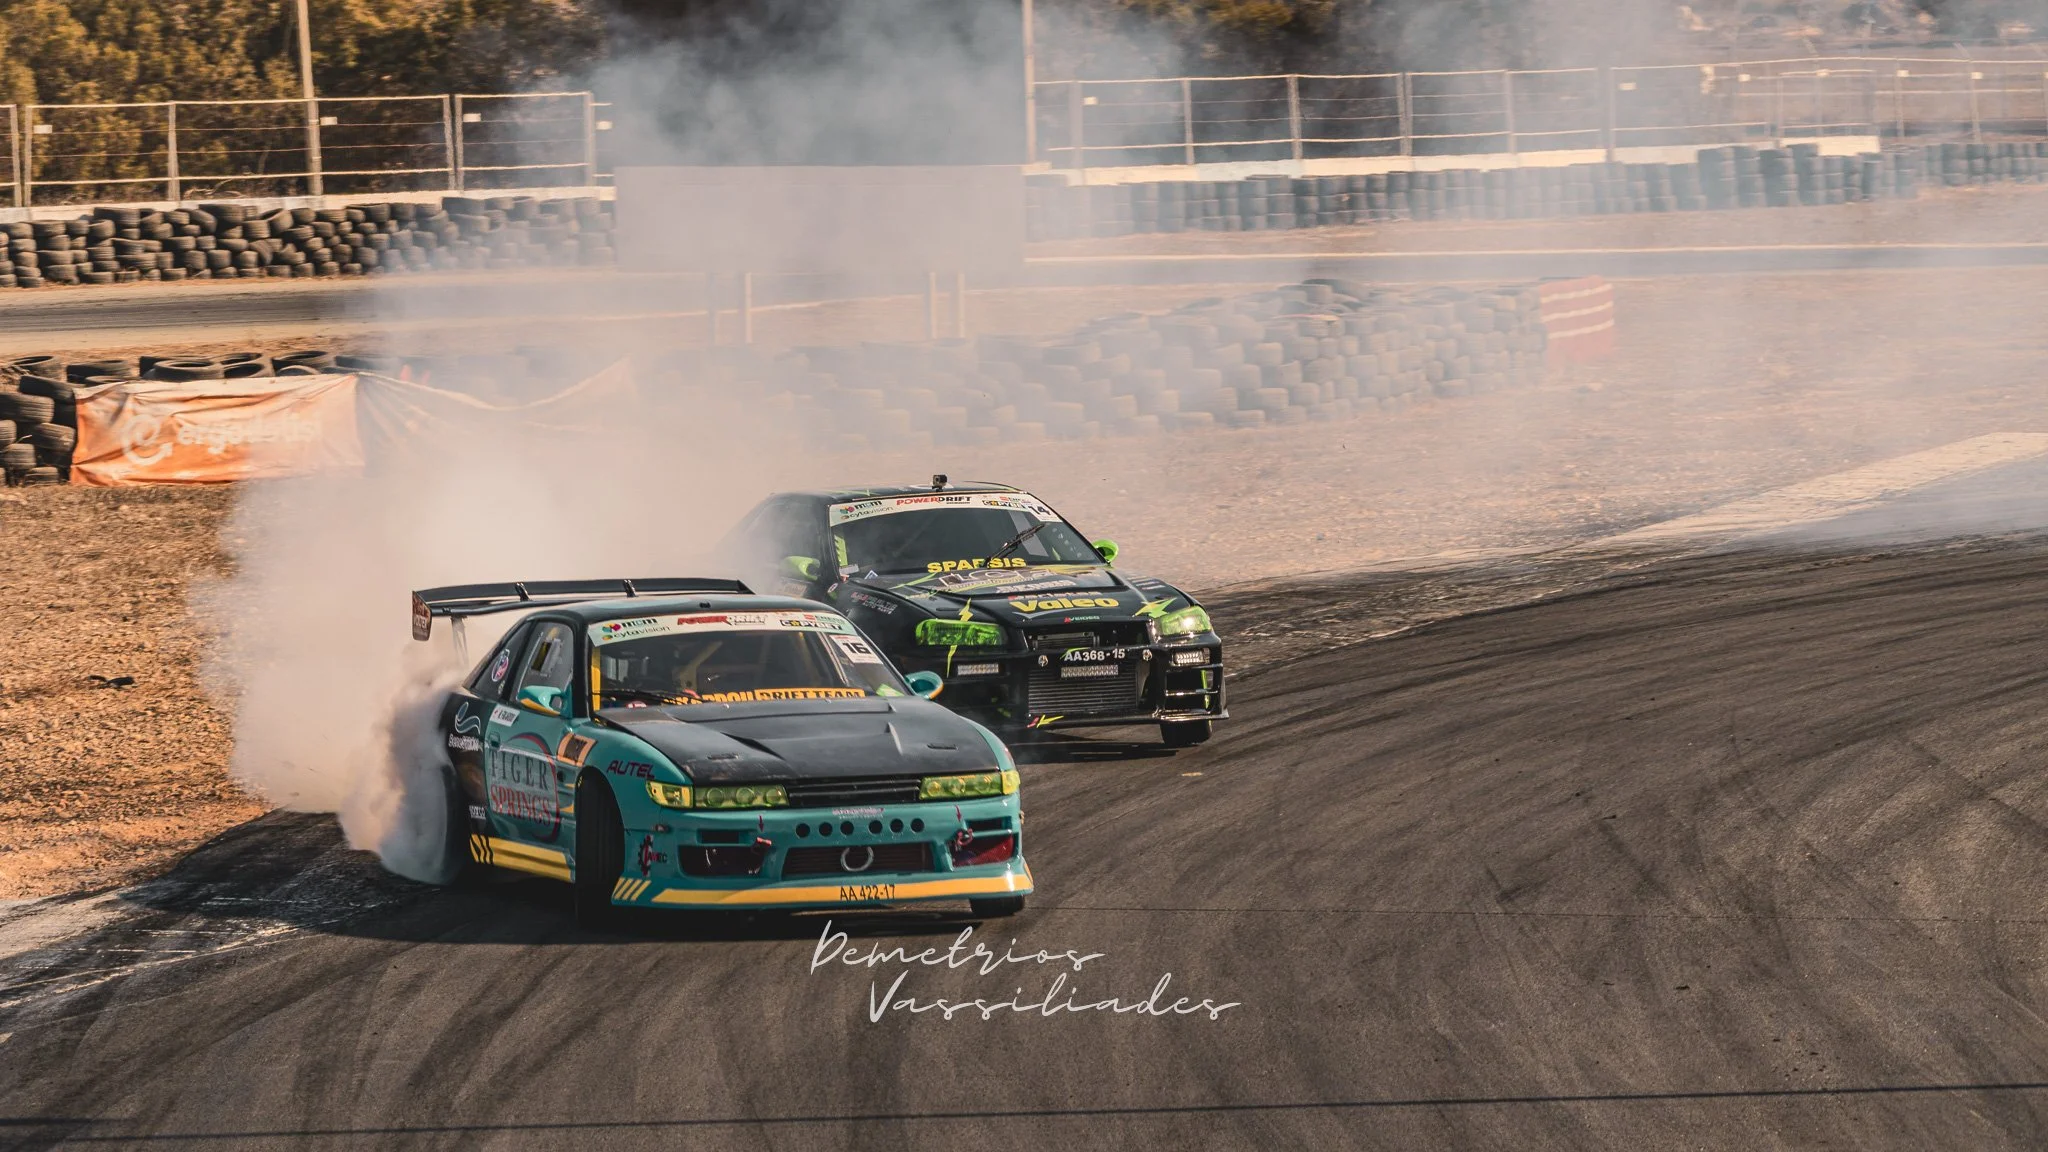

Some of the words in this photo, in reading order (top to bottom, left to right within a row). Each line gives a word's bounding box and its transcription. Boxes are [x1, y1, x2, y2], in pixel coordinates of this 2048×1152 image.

[896, 496, 971, 505] POWERDRIFT
[850, 506, 893, 518] cytavision
[1028, 505, 1051, 516] 14
[1009, 597, 1119, 613] Valeo
[614, 626, 671, 638] cytavision
[842, 642, 872, 655] 16
[759, 690, 811, 700] DRIFT
[814, 690, 862, 699] TEAM
[489, 748, 549, 792] TIGER
[606, 760, 656, 779] AUTEL
[490, 784, 551, 827] SPRINGS
[840, 885, 858, 901] AA
[859, 883, 896, 901] 422-17
